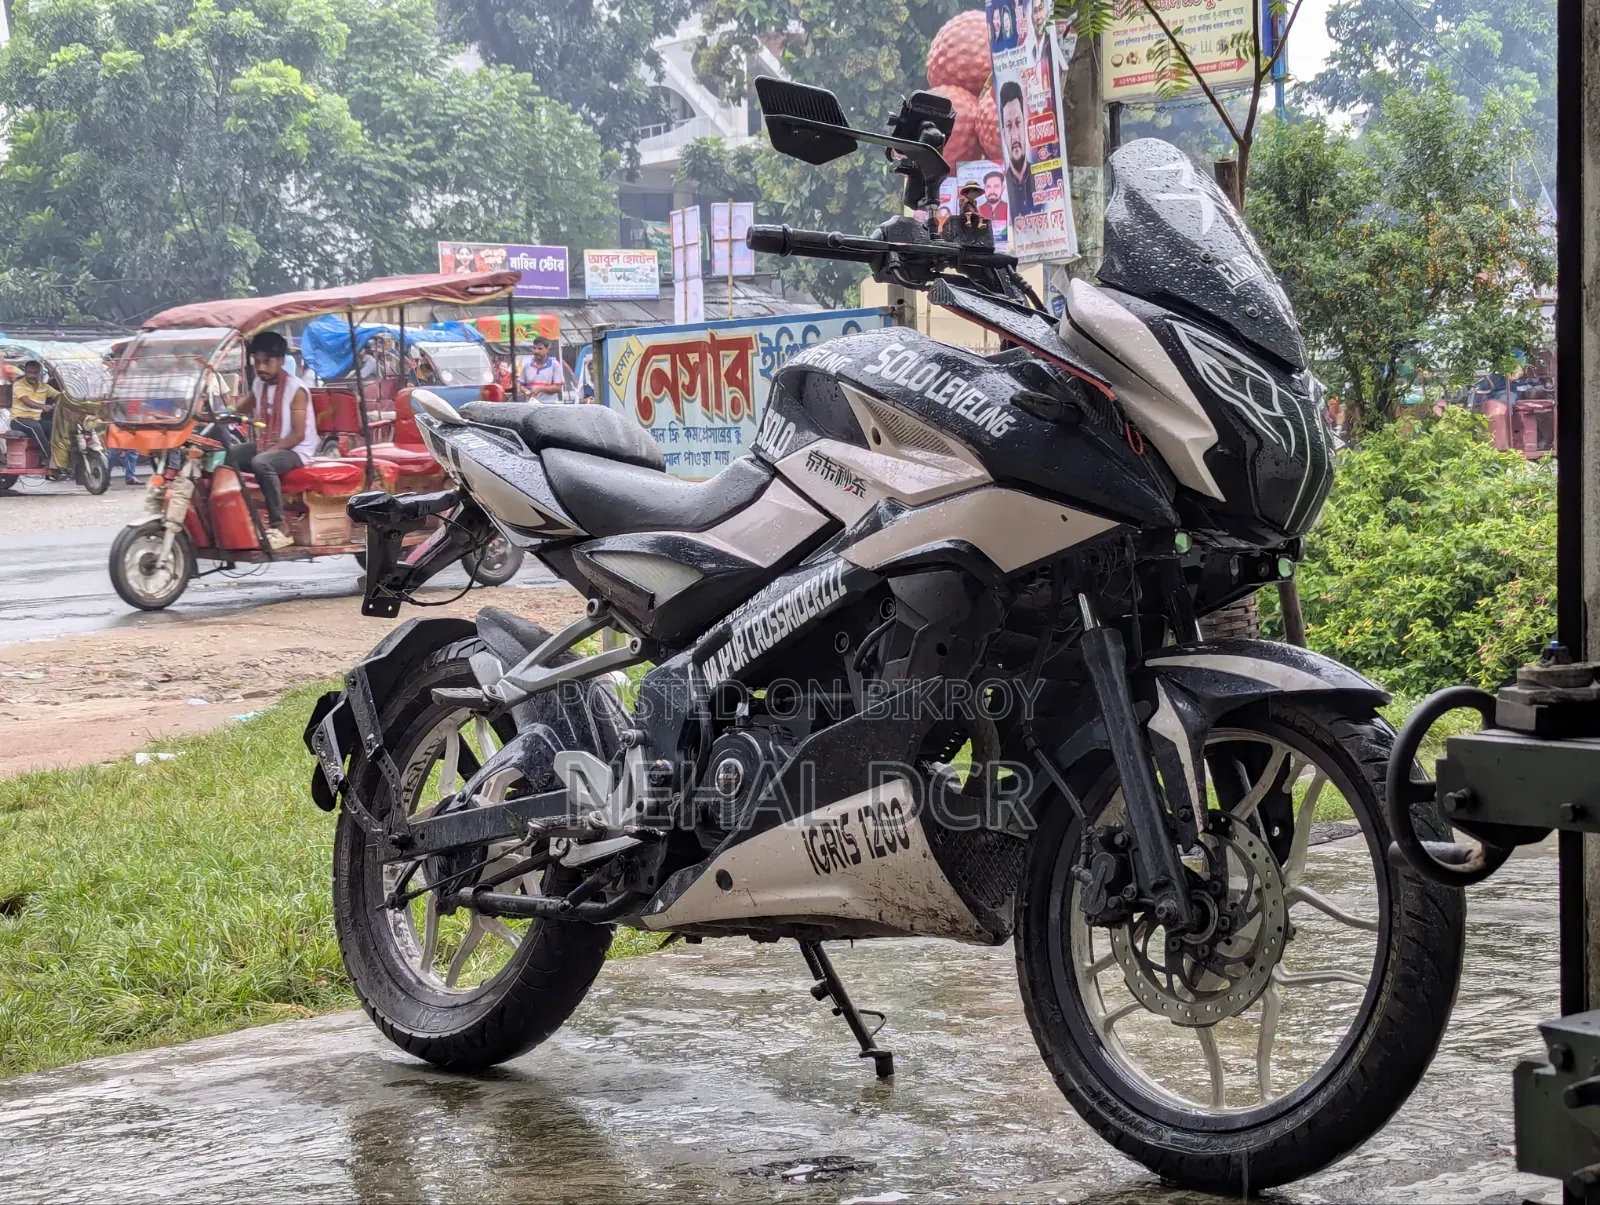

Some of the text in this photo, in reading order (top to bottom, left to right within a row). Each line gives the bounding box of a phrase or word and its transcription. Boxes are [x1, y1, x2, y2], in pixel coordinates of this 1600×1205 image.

[510, 252, 537, 271] মাহিন
[539, 255, 565, 272] স্টোর
[588, 253, 656, 268] আবুল হোটেল
[636, 331, 756, 425] নেসার
[863, 343, 935, 390] SOLO
[924, 371, 1018, 438] LEVELING
[684, 449, 711, 467] পাওয়া
[714, 450, 730, 466] যায়
[757, 408, 797, 460] SOLO
[801, 797, 910, 877] IGRIS 1200
